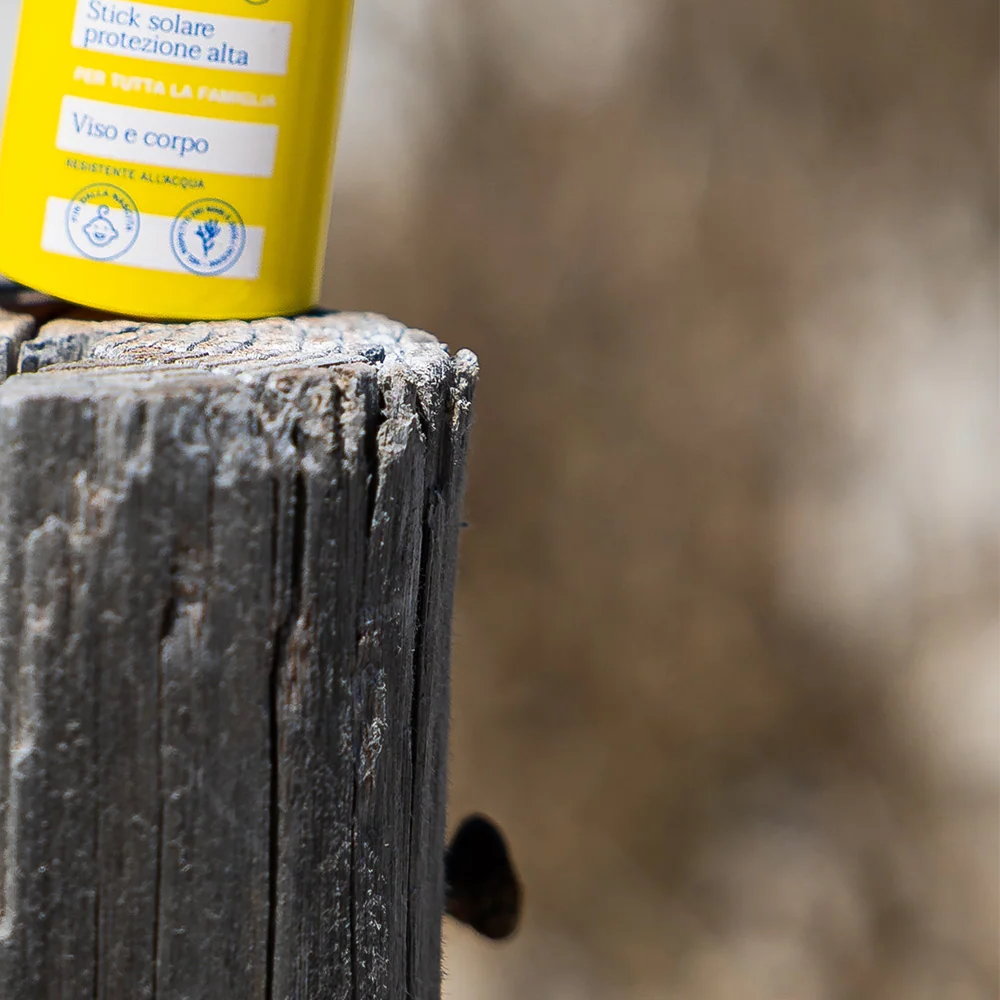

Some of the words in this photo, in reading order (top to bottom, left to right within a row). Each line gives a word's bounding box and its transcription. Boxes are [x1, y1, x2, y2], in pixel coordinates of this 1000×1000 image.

[87, 0, 141, 28] Stick
[148, 14, 216, 39] solare
[82, 25, 201, 61] protezione
[207, 43, 250, 67] alta
[73, 65, 106, 87] PER
[111, 72, 166, 96] TUTTA
[170, 83, 194, 100] LA
[72, 111, 119, 142] Viso
[124, 128, 138, 144] e
[143, 130, 210, 158] corpo
[66, 158, 135, 181] RESISTENTE
